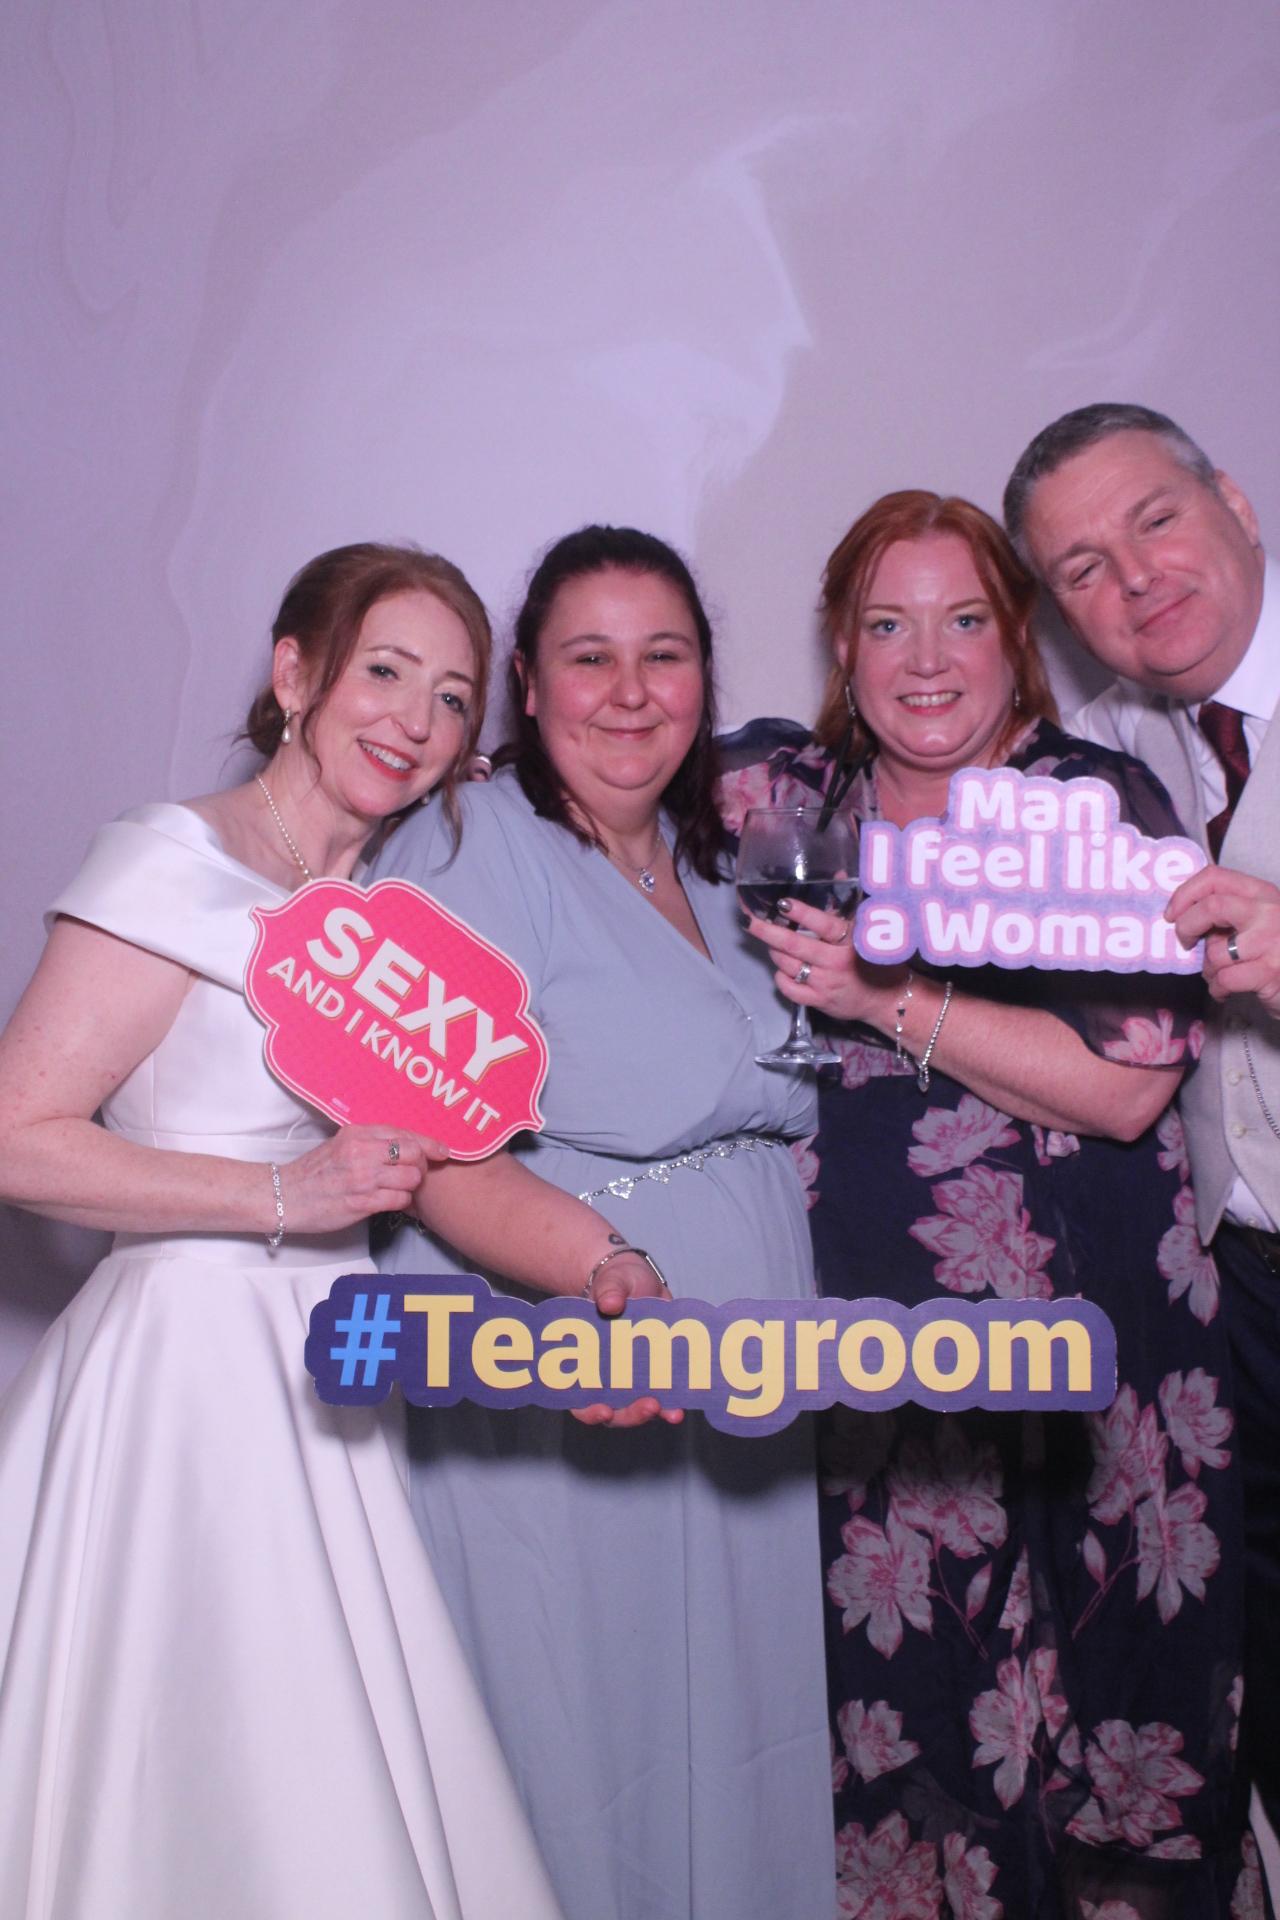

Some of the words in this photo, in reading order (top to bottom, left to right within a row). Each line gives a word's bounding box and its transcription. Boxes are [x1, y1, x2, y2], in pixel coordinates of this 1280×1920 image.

[958, 779, 1110, 832] Man
[871, 833, 888, 884] I
[909, 830, 1045, 888] feel
[1067, 832, 1195, 892] like
[866, 908, 905, 951] a
[306, 907, 529, 1083] SEXY
[266, 956, 345, 1019] AND
[344, 1008, 364, 1034] I
[359, 1020, 468, 1108] KNOW
[462, 1097, 501, 1132] IT
[330, 1293, 1093, 1418] #Teamgroom
